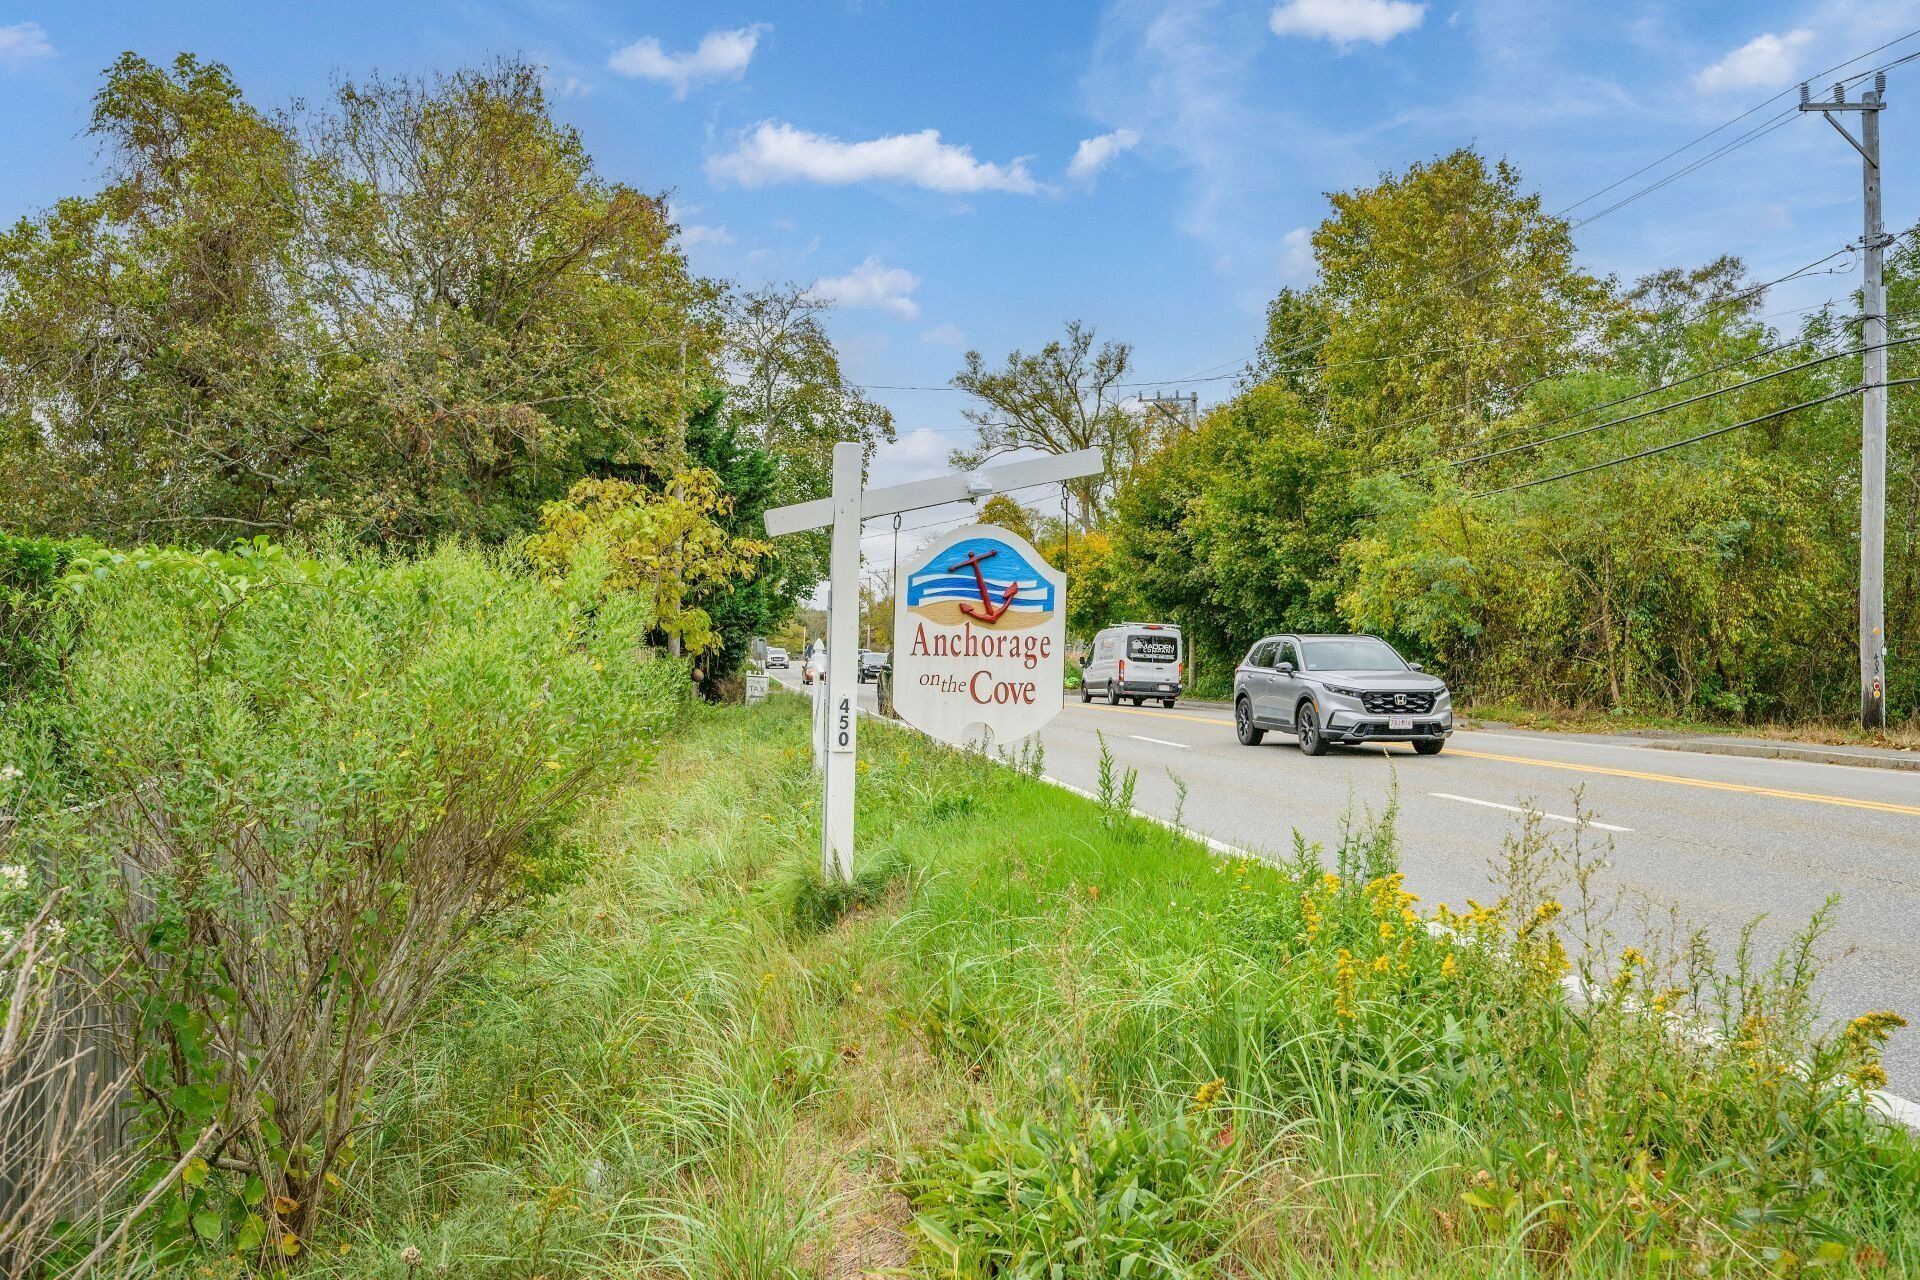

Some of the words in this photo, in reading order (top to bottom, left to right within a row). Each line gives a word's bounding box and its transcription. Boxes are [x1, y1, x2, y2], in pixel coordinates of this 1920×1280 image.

[910, 622, 1051, 669] Anchorage
[1142, 643, 1175, 651] MADDEN
[919, 673, 940, 686] on
[941, 674, 967, 693] the
[969, 670, 1036, 705] Cove
[838, 698, 850, 747] 450
